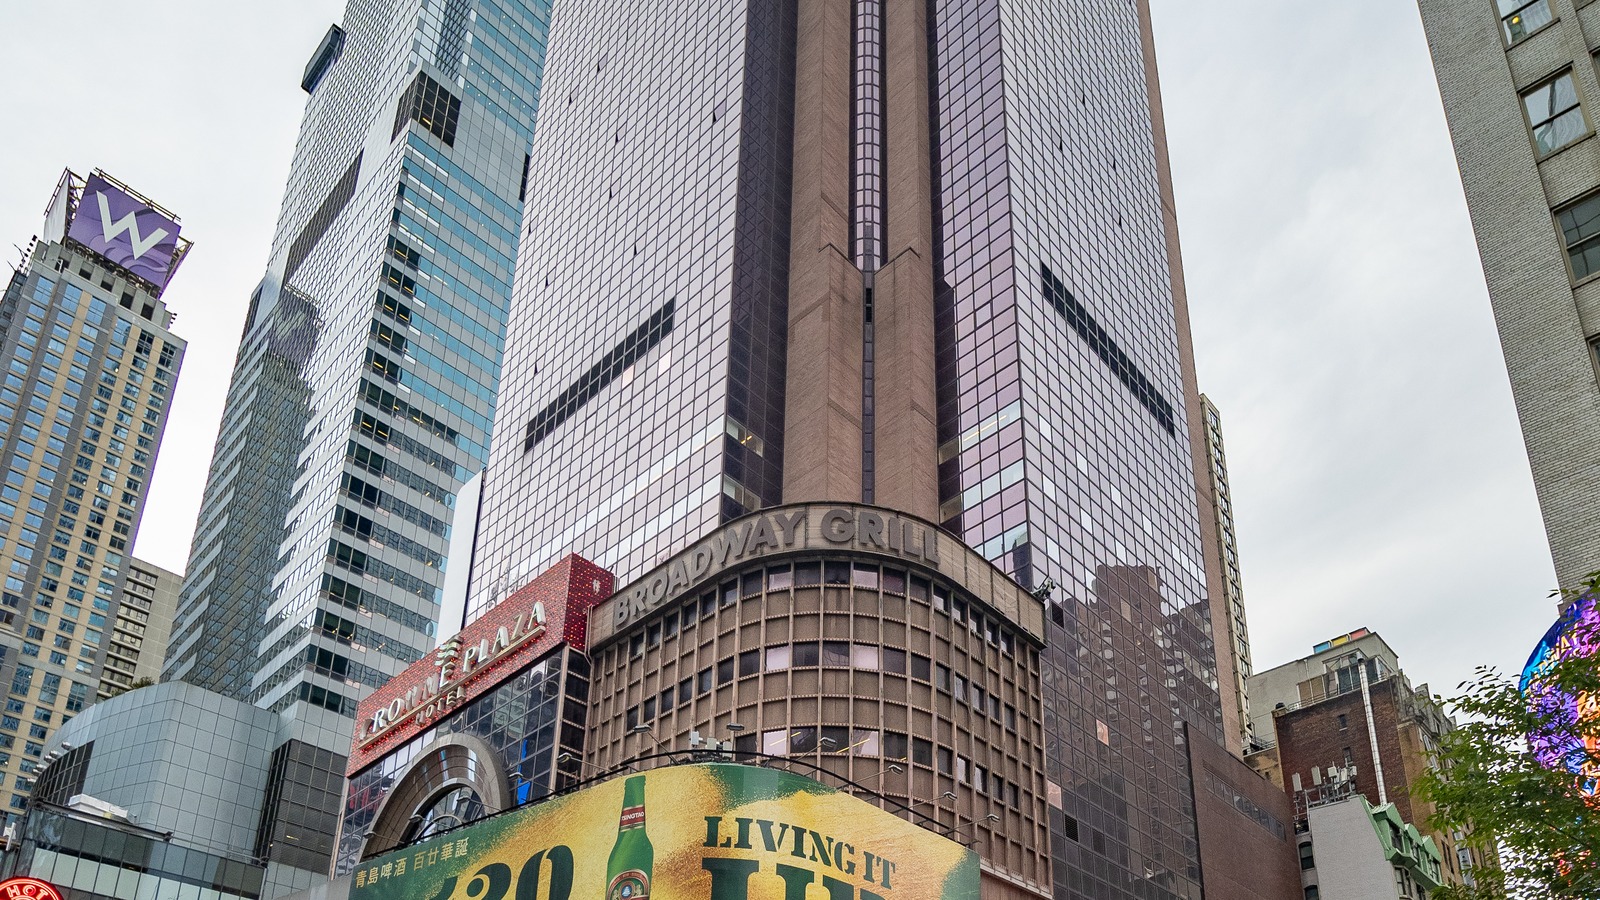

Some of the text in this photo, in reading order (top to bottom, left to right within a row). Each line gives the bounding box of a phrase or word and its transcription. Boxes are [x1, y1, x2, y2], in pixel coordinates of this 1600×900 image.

[96, 190, 169, 260] W
[612, 509, 941, 629] BROADWAY GRILL
[463, 601, 546, 673] PLAZA
[416, 686, 466, 726] HOTEL
[356, 837, 469, 888] 青島啤酒 百廿華誕
[703, 815, 856, 875] LIVING
[862, 850, 896, 890] IT
[6, 884, 49, 900] HOT
